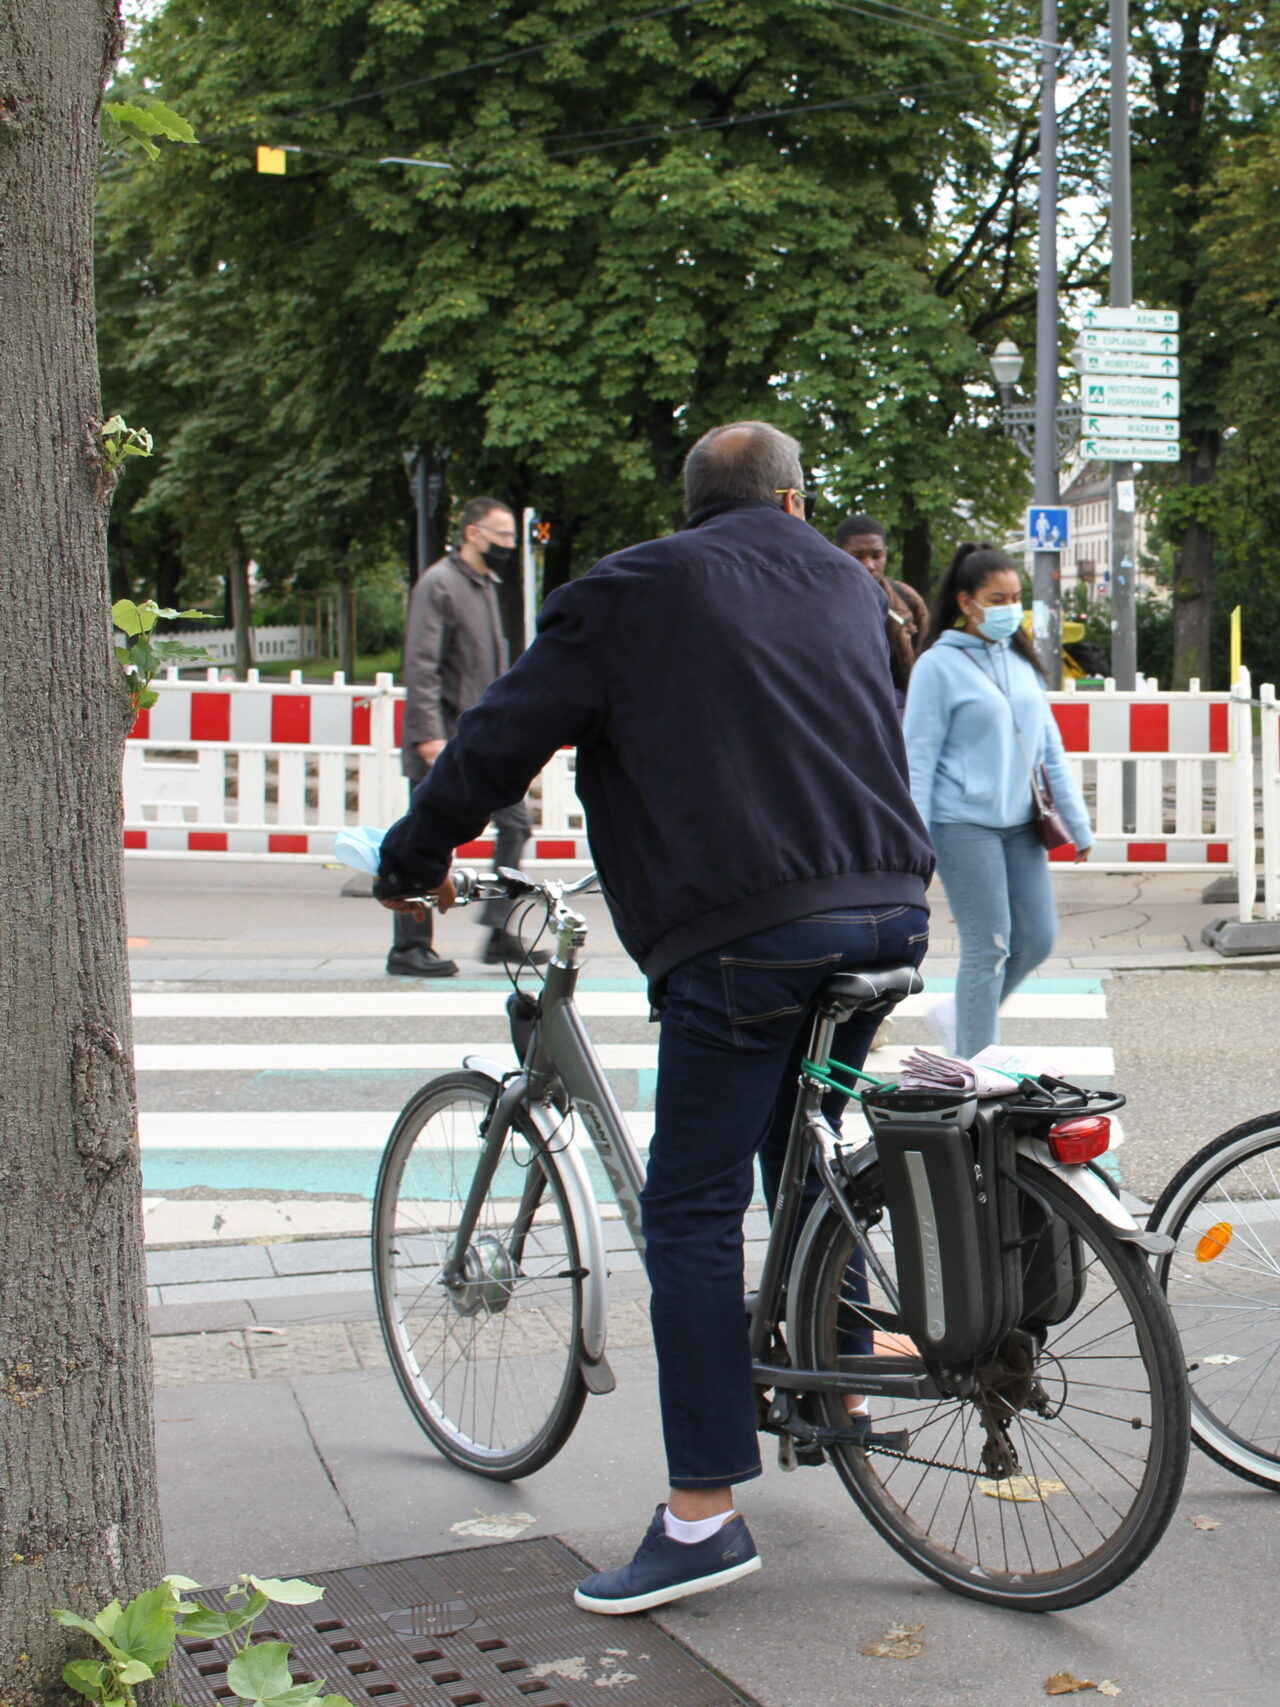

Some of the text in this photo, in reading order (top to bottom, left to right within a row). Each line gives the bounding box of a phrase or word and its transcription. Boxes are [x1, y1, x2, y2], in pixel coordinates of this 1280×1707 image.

[1137, 315, 1158, 324] KEHL
[1103, 336, 1147, 346] ESPLANADE
[1104, 359, 1150, 369] ROBERTSAU
[1107, 384, 1159, 395] INSTITUTIONS
[1127, 424, 1159, 433] WACKEN
[1099, 445, 1120, 454] Place
[1131, 445, 1166, 455] Bordeaux
